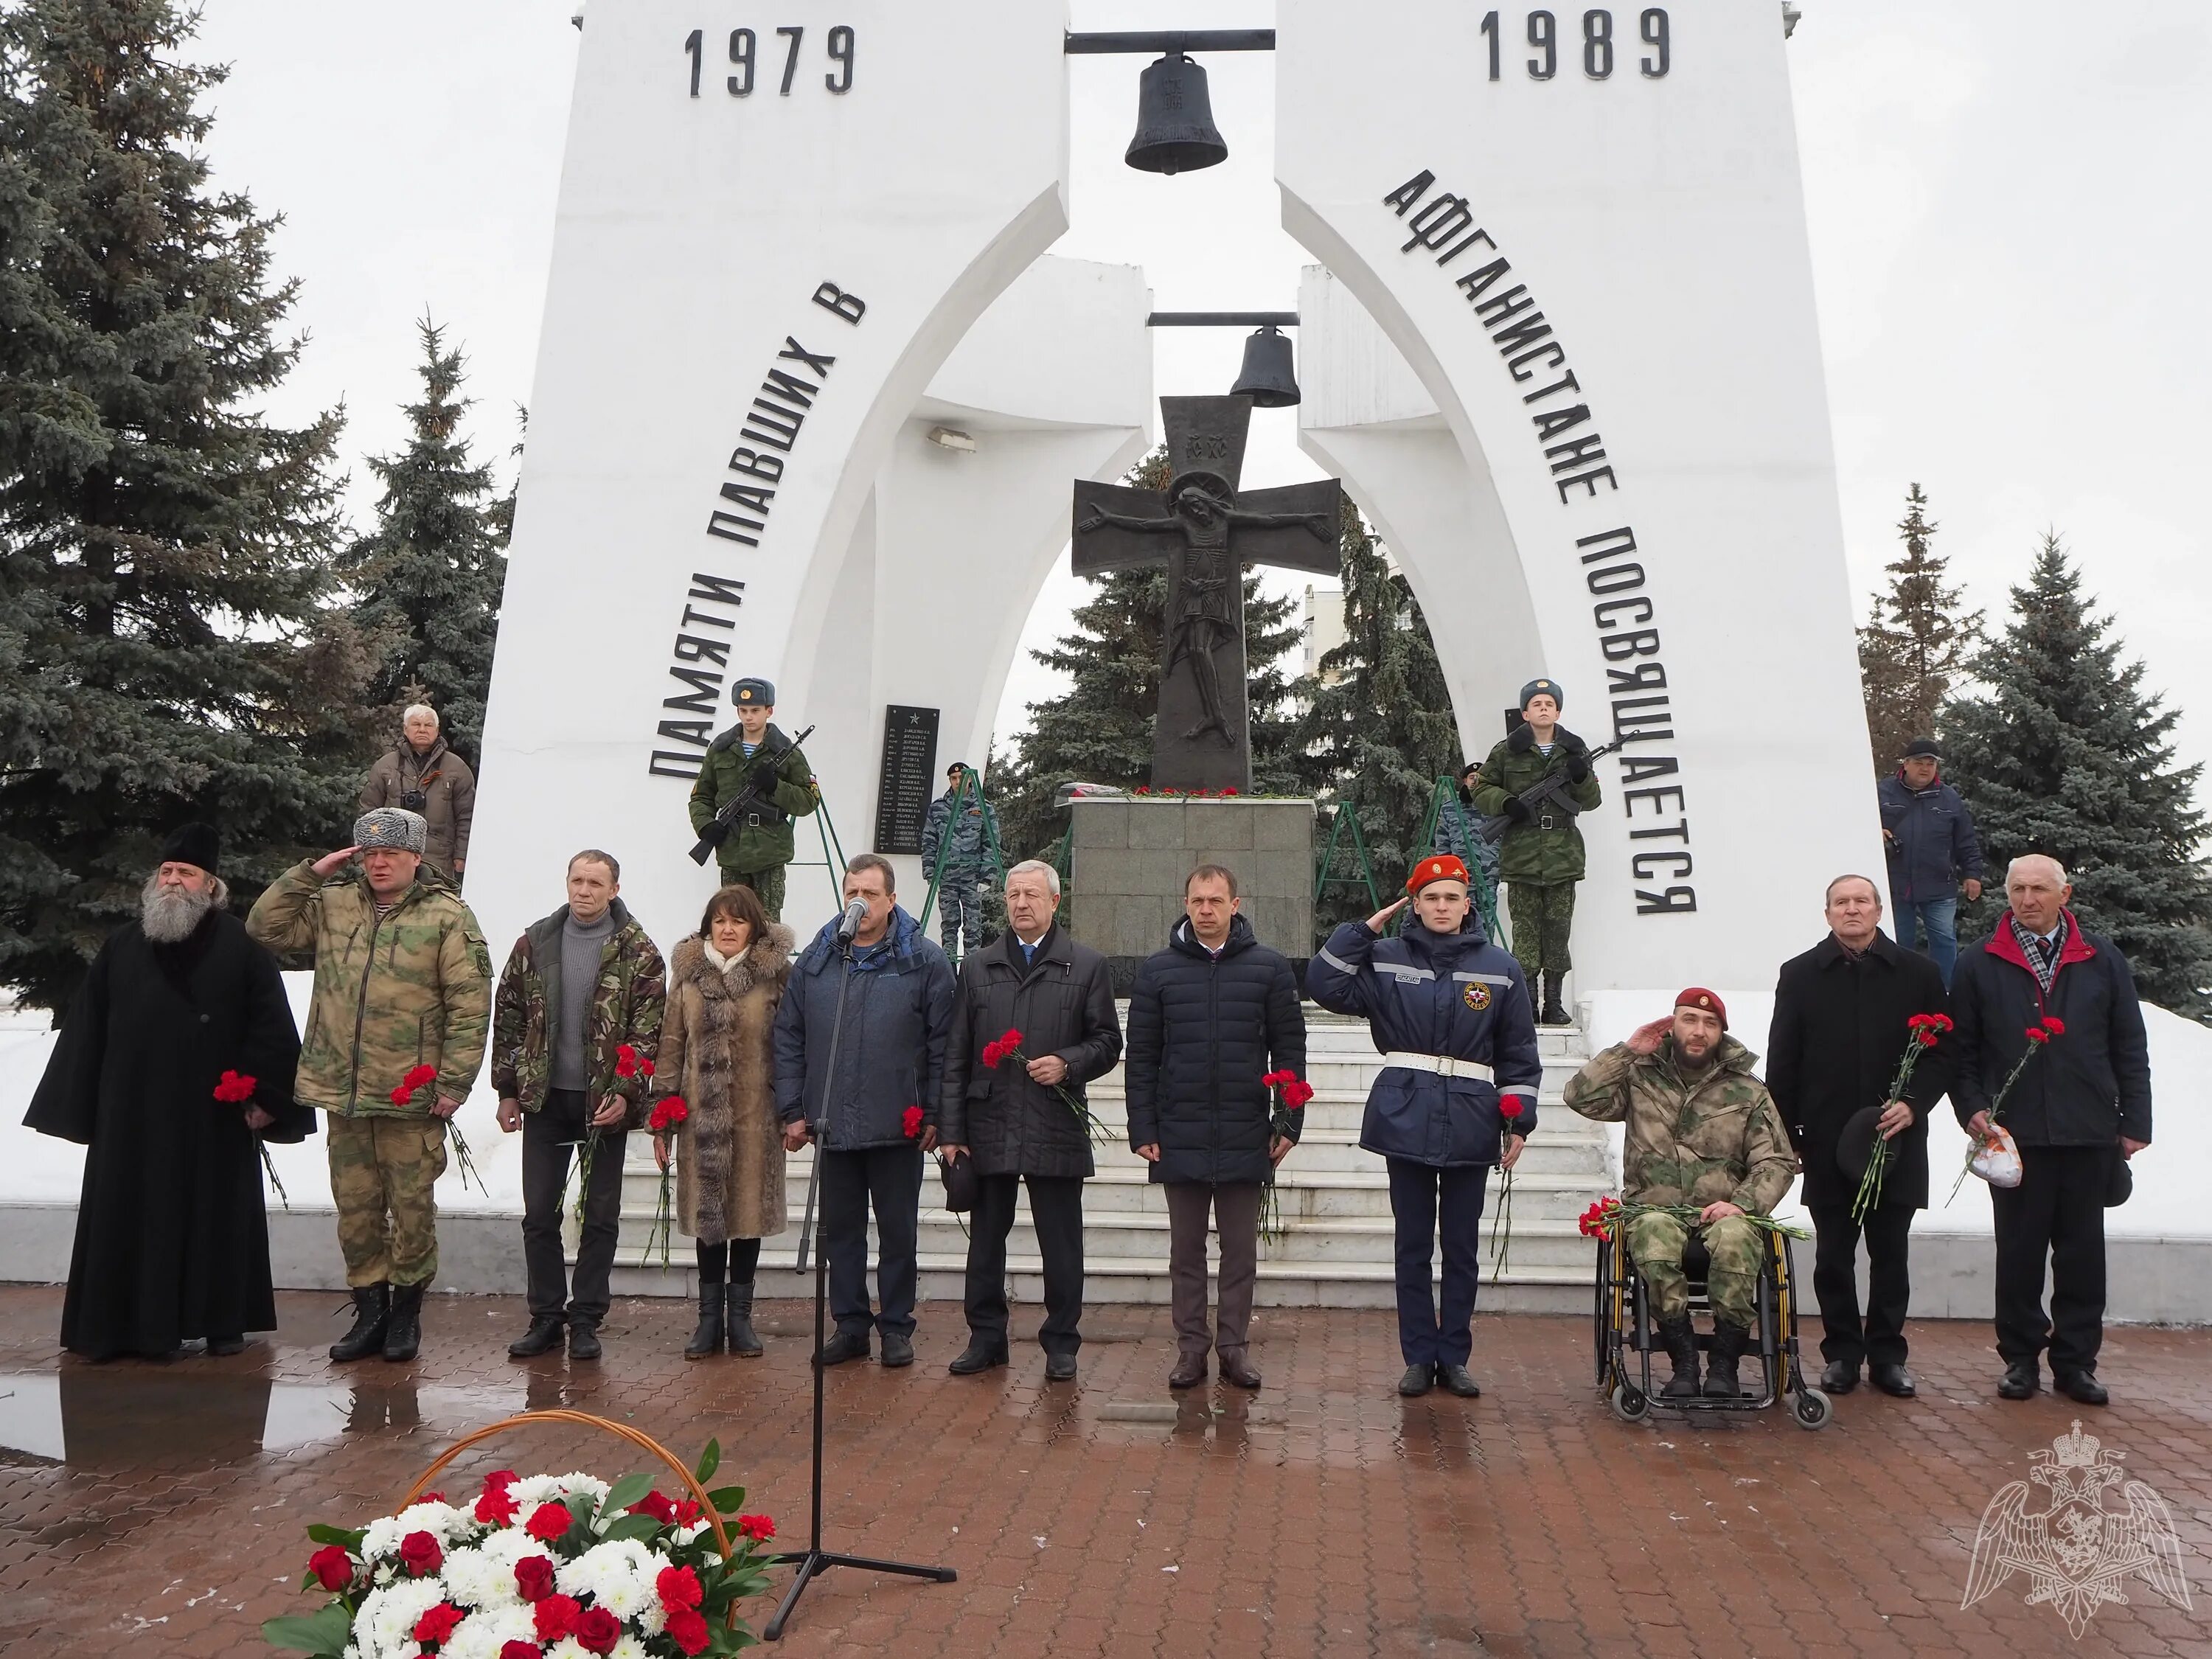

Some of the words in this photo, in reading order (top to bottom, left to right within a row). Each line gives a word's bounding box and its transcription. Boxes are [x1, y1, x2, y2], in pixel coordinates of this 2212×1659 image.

[684, 25, 856, 98] 1979
[1480, 7, 1670, 81] 1989
[649, 573, 747, 779] ПАМЯТИ
[706, 335, 838, 549] ПАВШИХ
[812, 280, 868, 327] В
[1382, 169, 1619, 506] АФГАНИСТАНЕ
[1575, 526, 1697, 916] ПОСВЯЩАЕТСЯ
